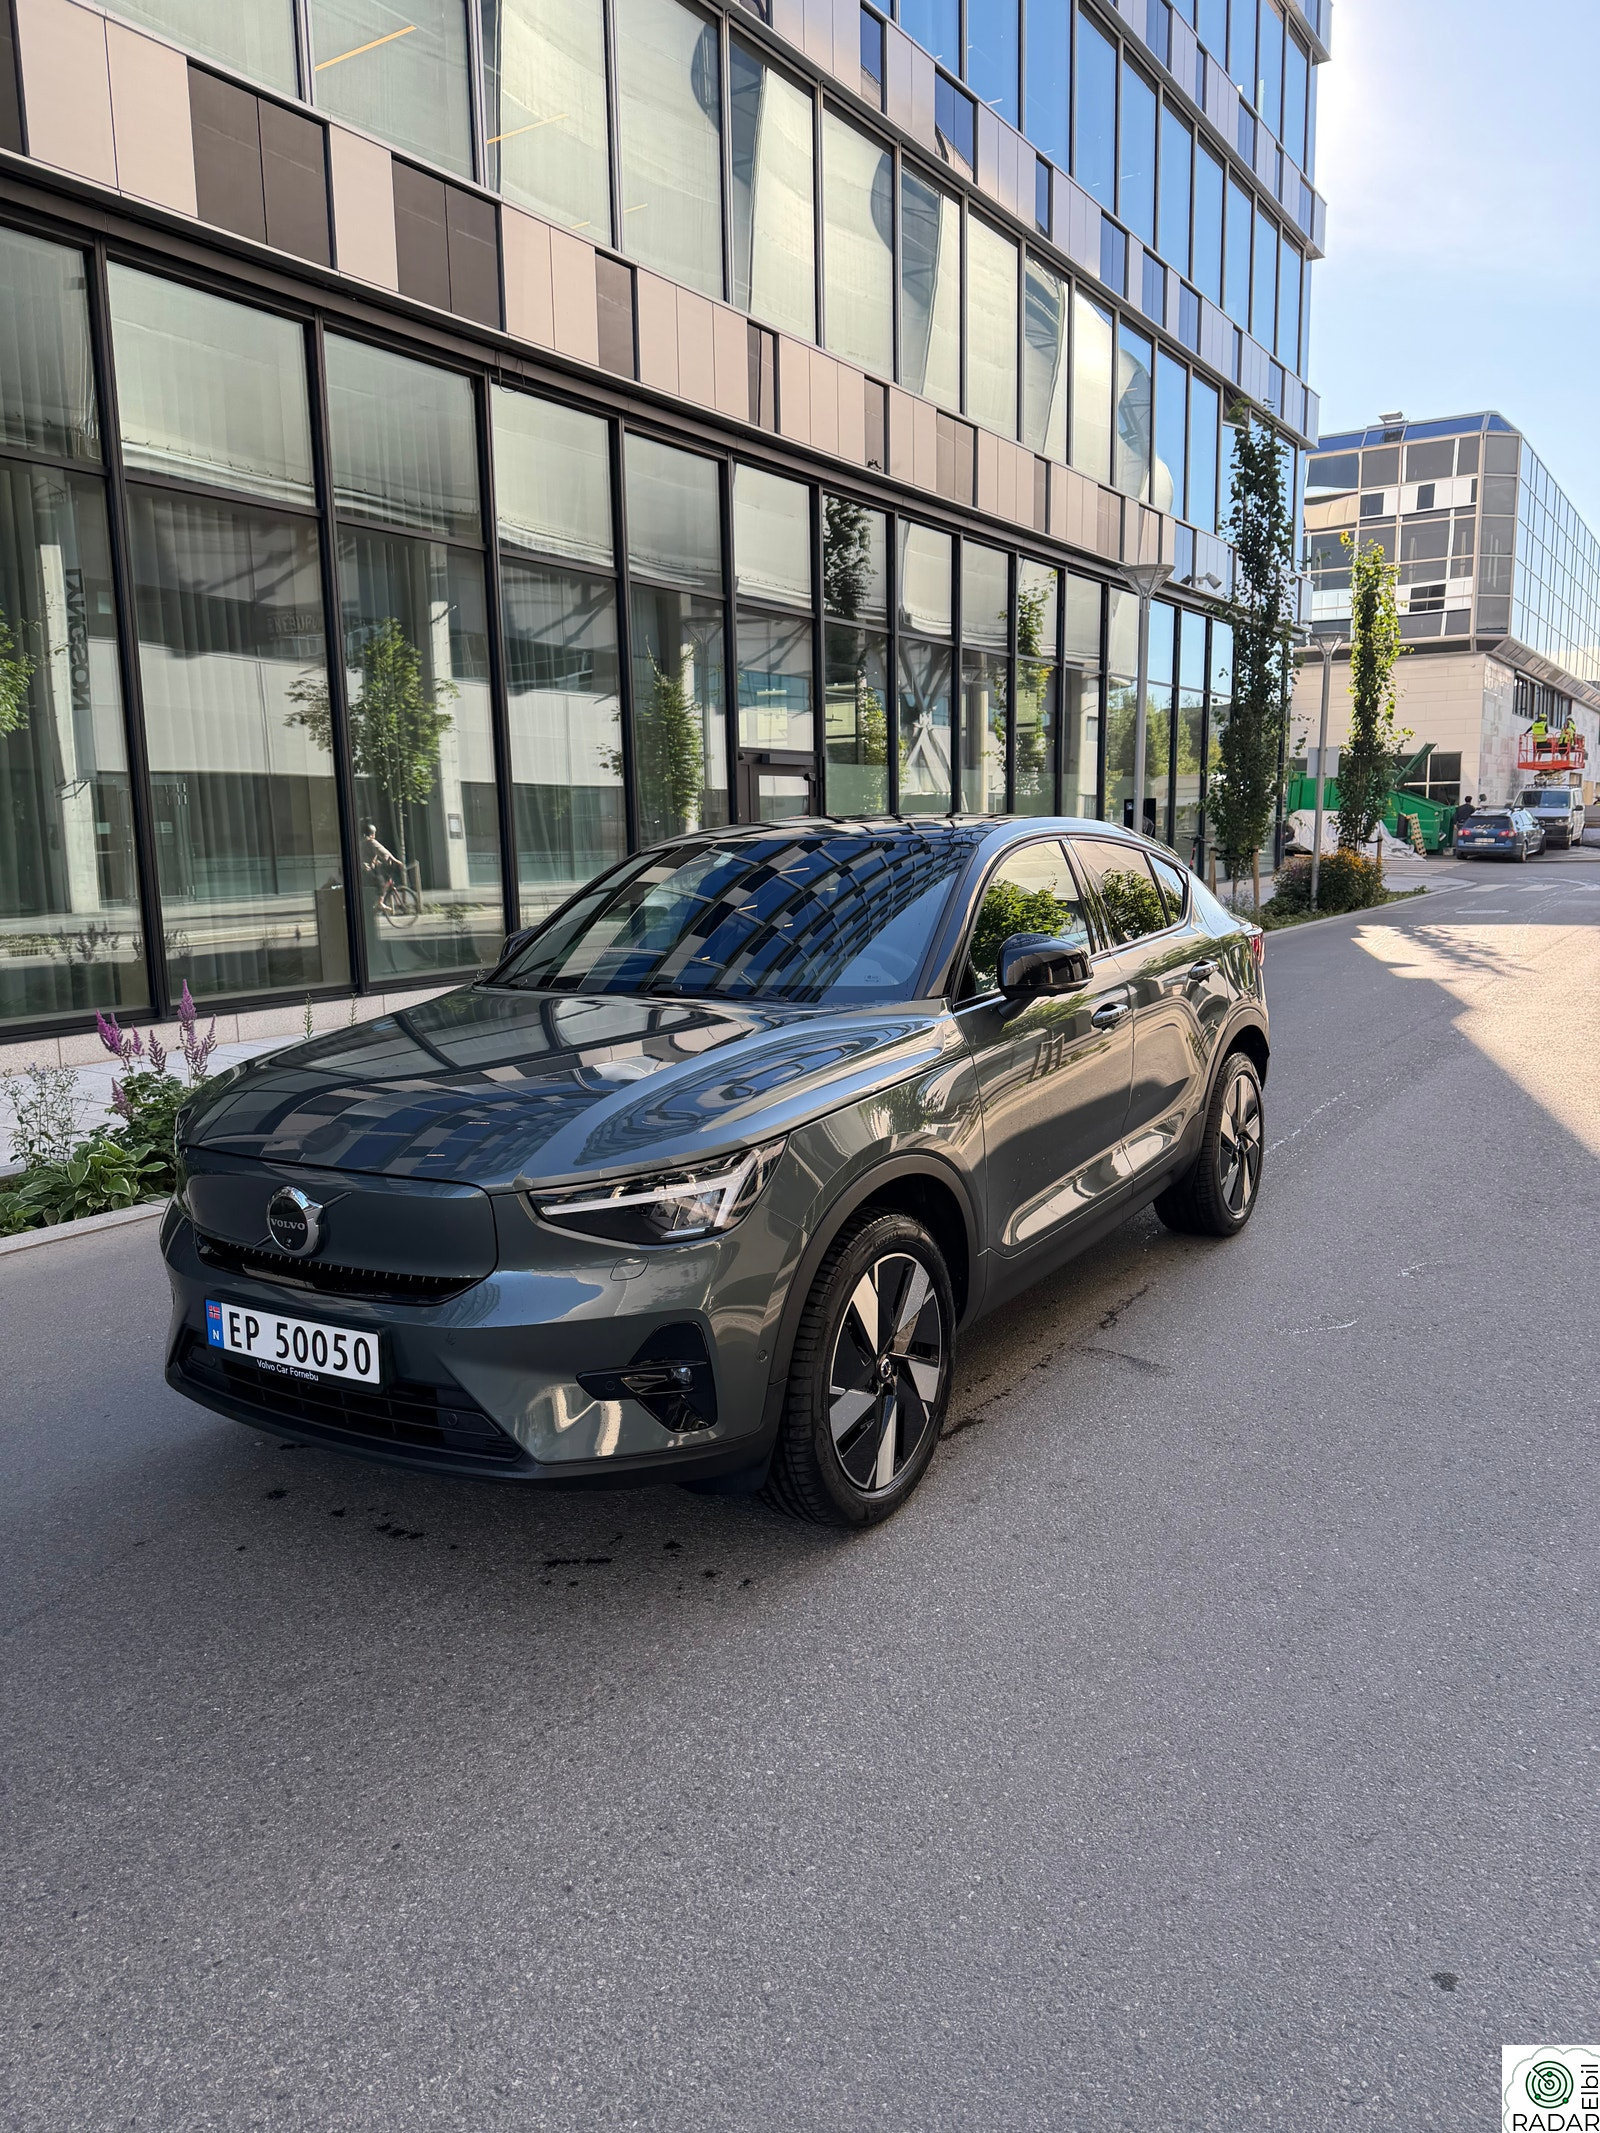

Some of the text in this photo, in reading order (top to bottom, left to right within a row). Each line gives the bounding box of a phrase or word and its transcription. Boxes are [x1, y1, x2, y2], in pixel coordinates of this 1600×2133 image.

[270, 1218, 306, 1231] VOLVO
[212, 1329, 220, 1341] N
[229, 1311, 371, 1376] EP 50050
[257, 1359, 319, 1382] Volvo Car Fornebu
